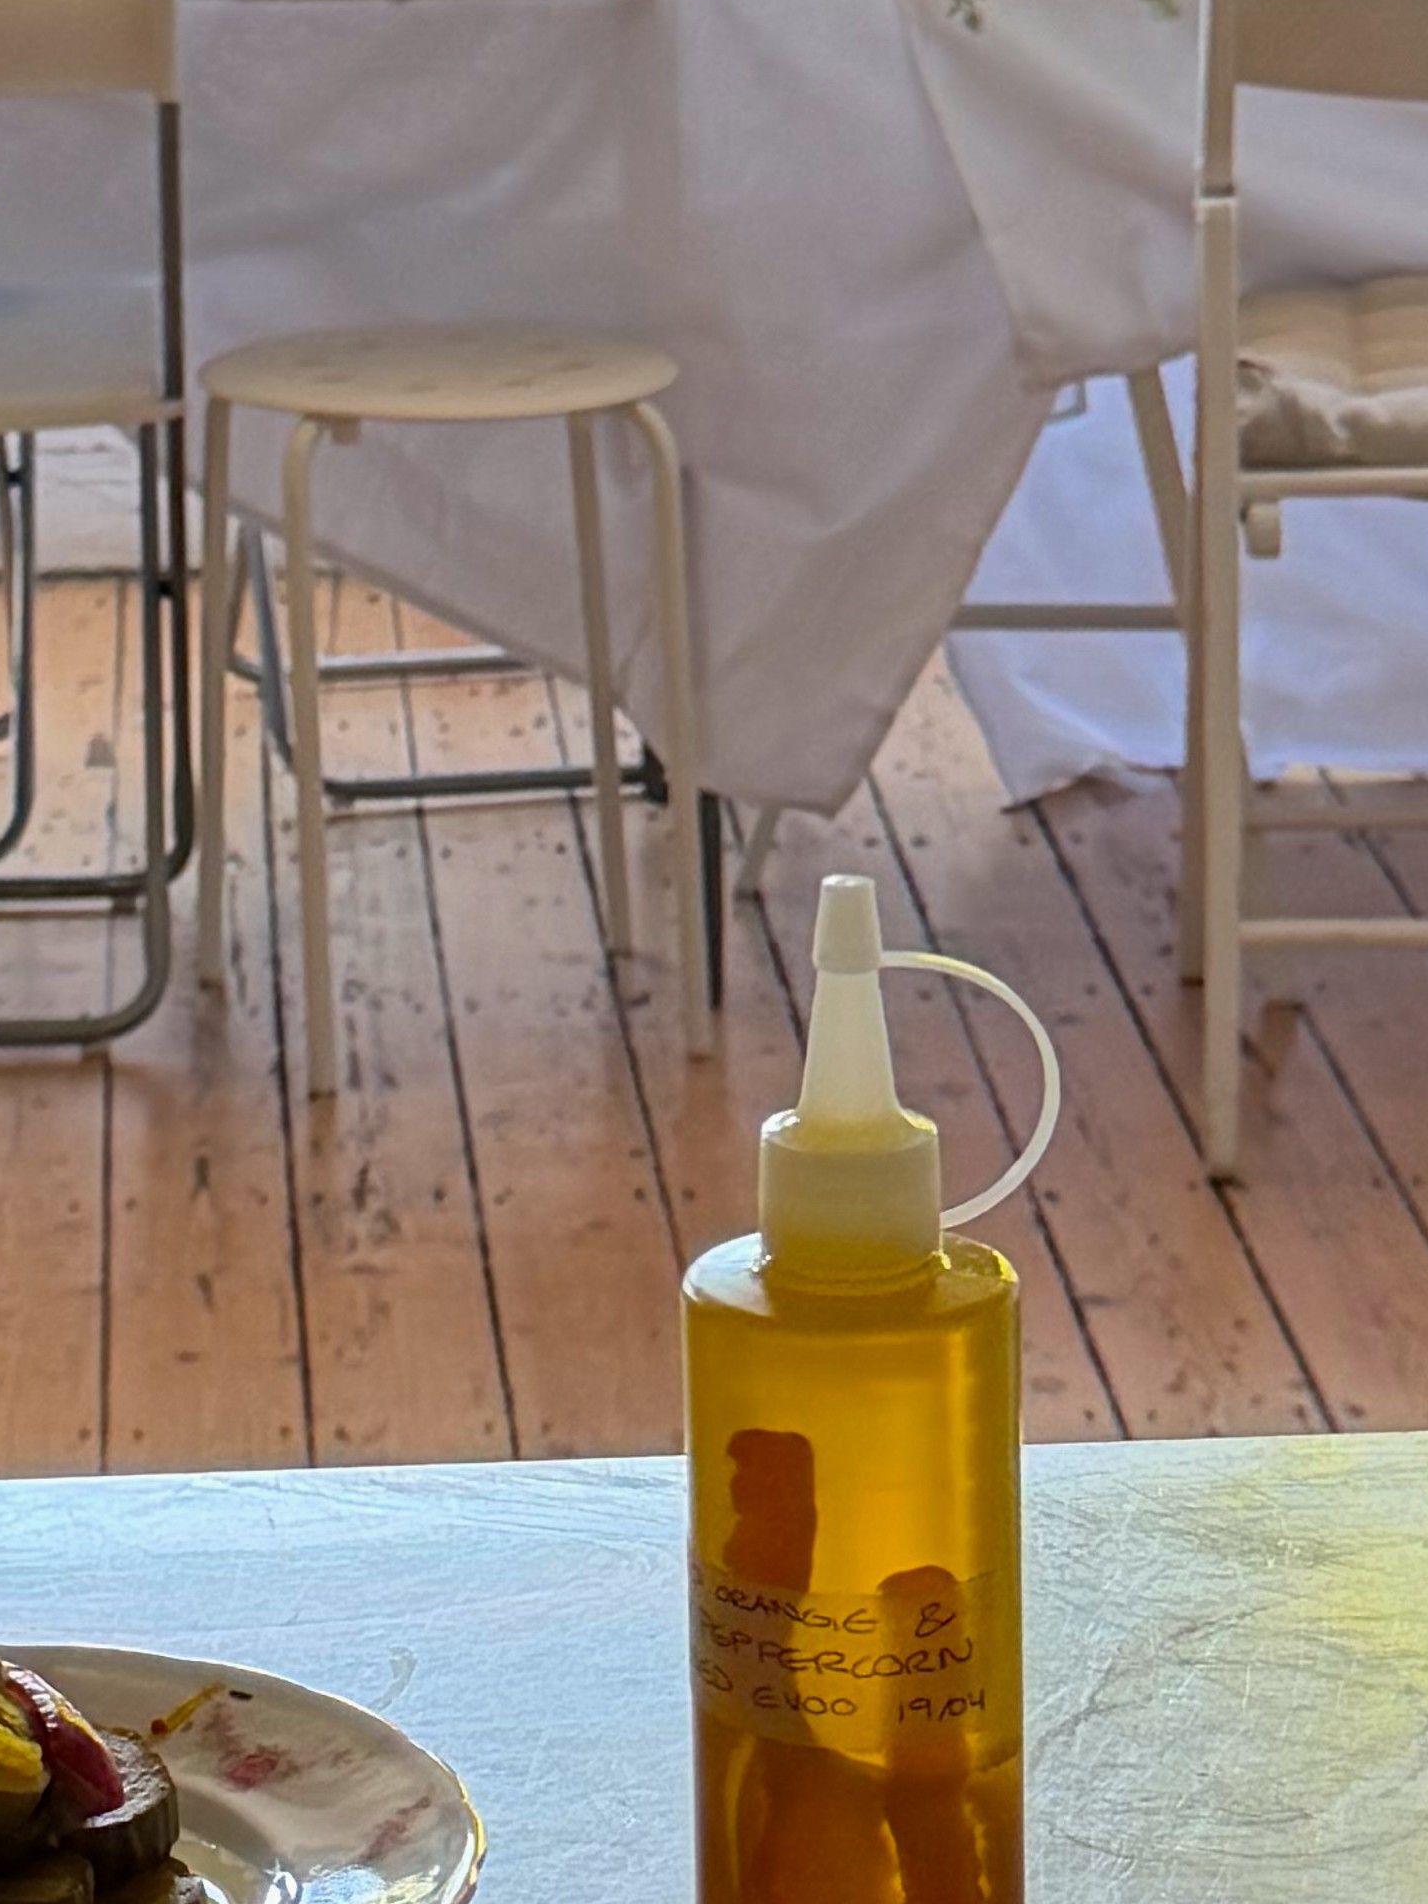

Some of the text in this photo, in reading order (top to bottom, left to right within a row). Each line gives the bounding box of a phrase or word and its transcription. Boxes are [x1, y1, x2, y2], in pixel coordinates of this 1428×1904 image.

[714, 1584, 956, 1639] ORANGE &
[752, 1685, 859, 1717] EVOO
[897, 1688, 986, 1723] 19/04
